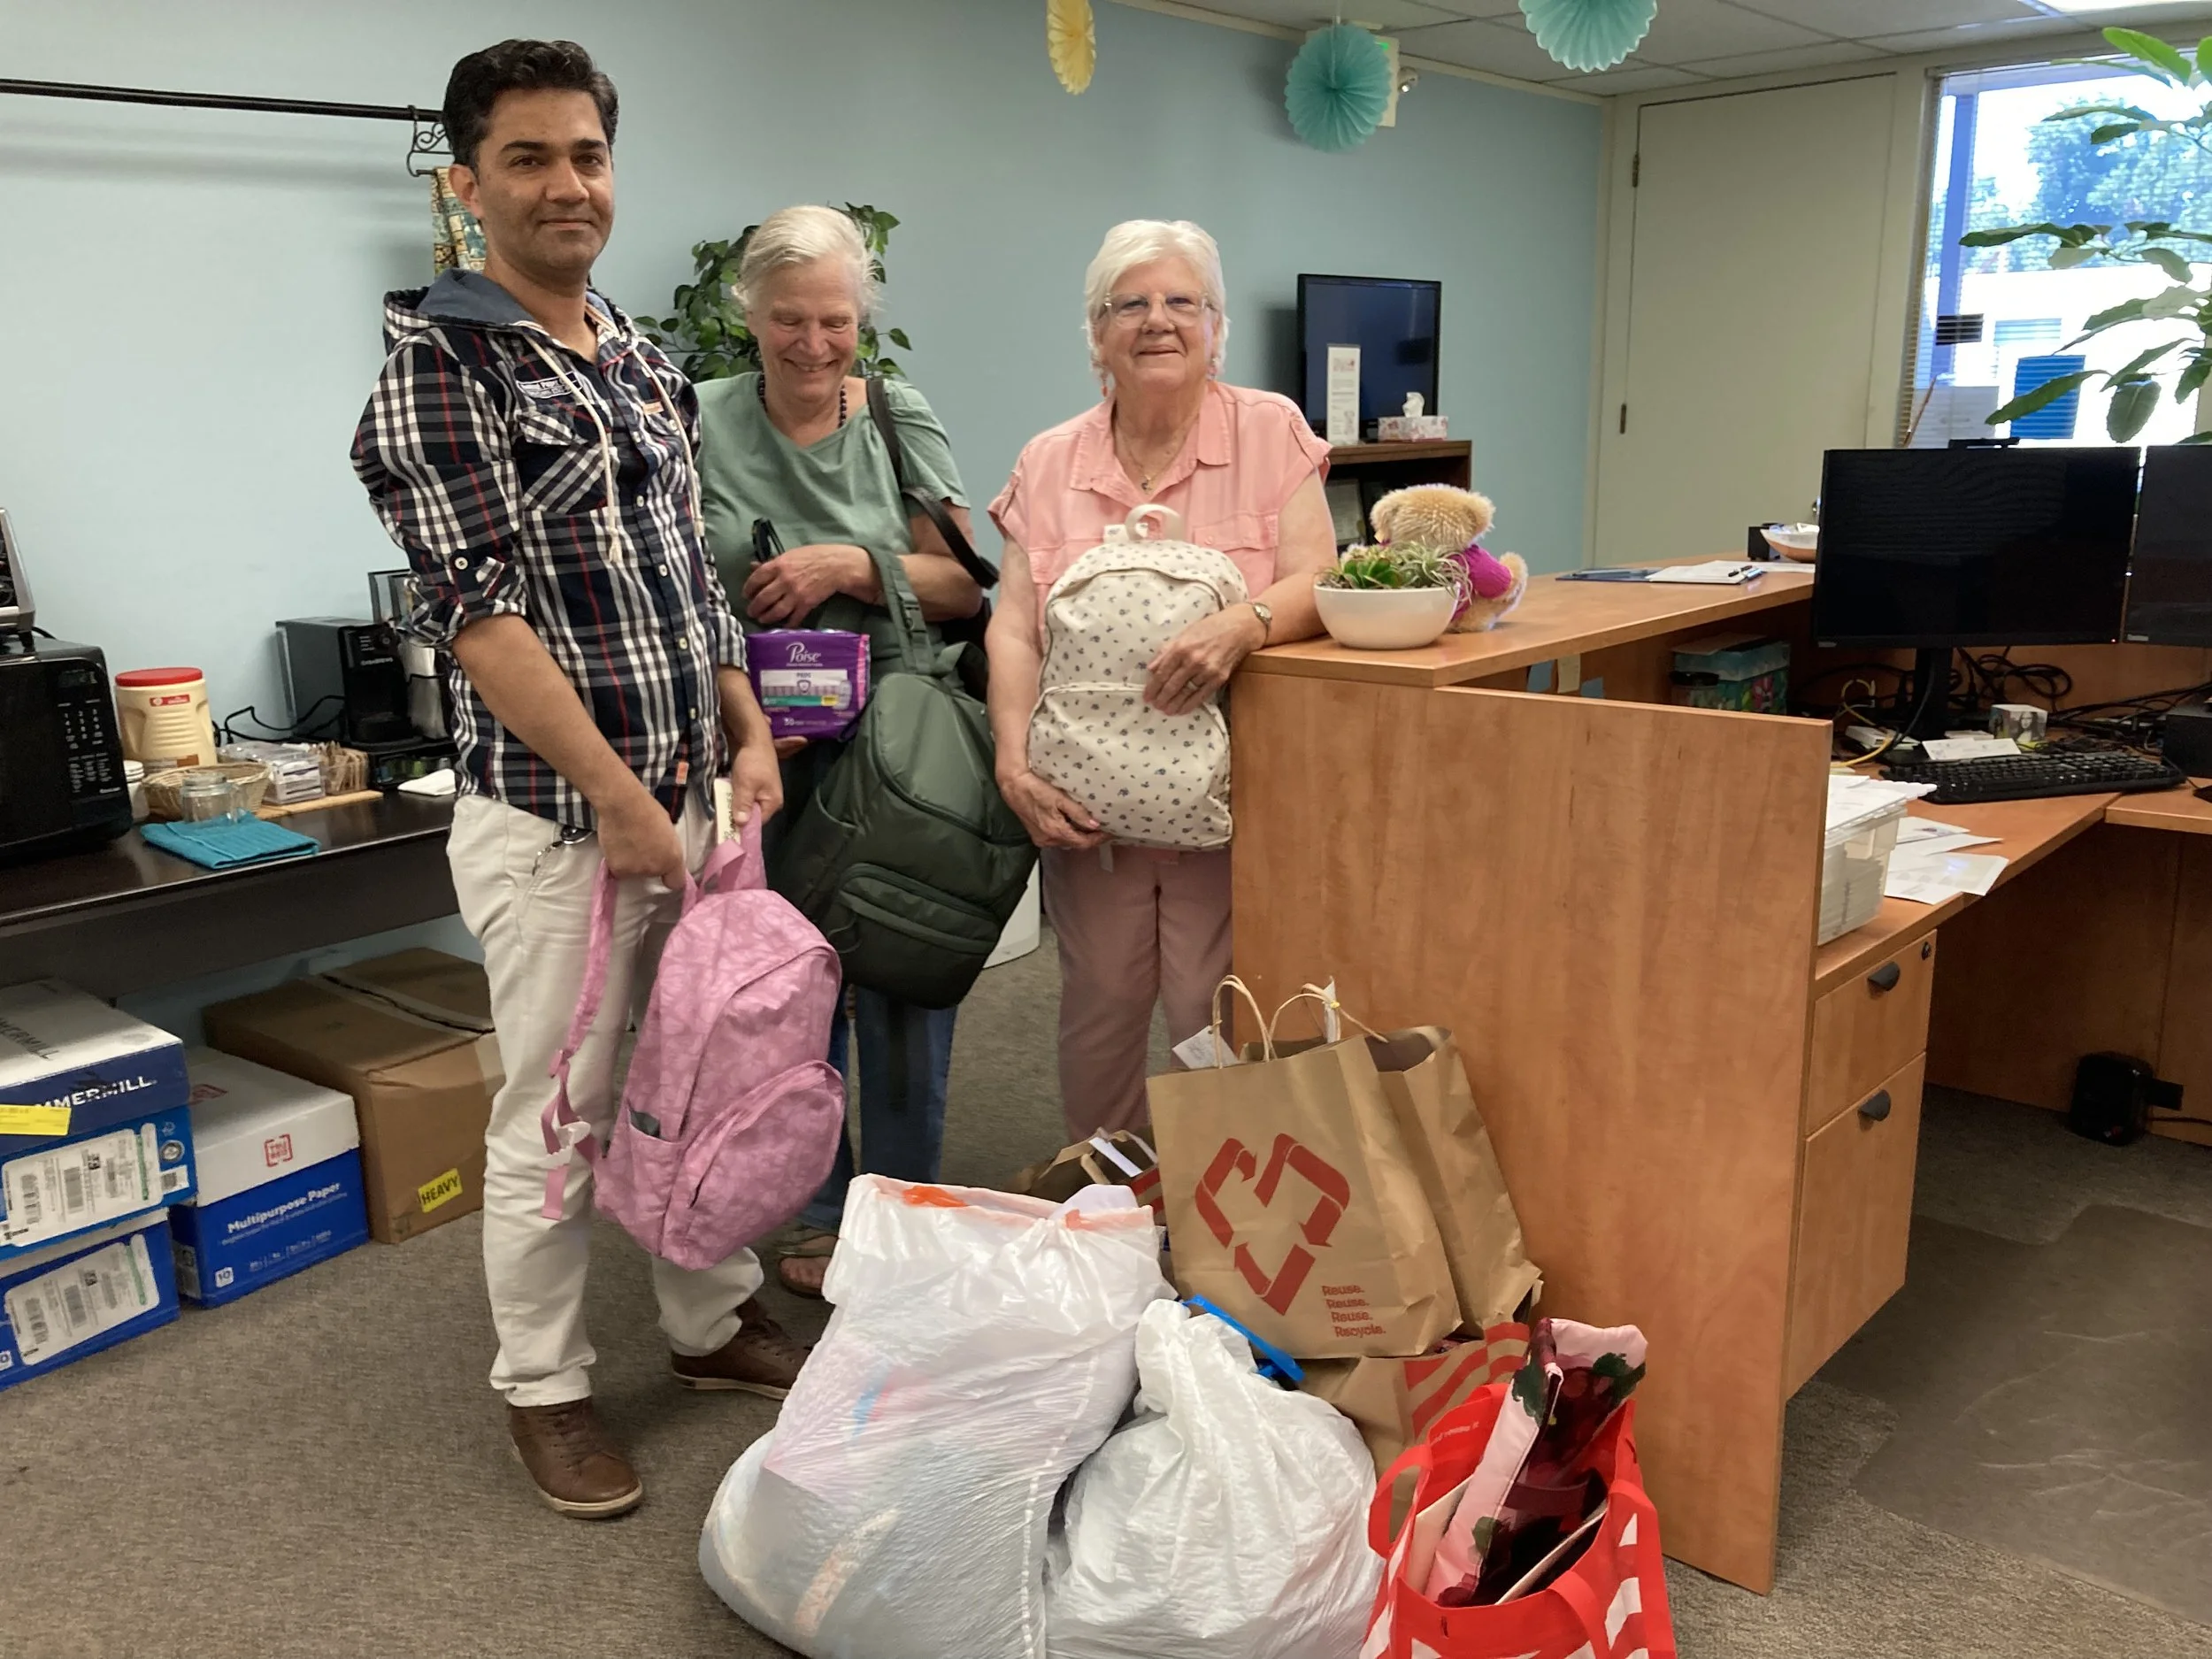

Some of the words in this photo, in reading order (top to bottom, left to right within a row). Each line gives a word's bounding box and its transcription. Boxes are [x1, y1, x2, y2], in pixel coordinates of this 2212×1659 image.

[786, 641, 822, 663] Poise
[421, 1176, 457, 1205] HEAVY
[227, 1197, 307, 1233] Multipurpose
[308, 1182, 341, 1202] Paper
[1322, 1285, 1365, 1296] Reuse.
[1325, 1298, 1371, 1310] Reuse.
[1331, 1311, 1374, 1323] Reuse.
[1334, 1324, 1386, 1338] Recycle.
